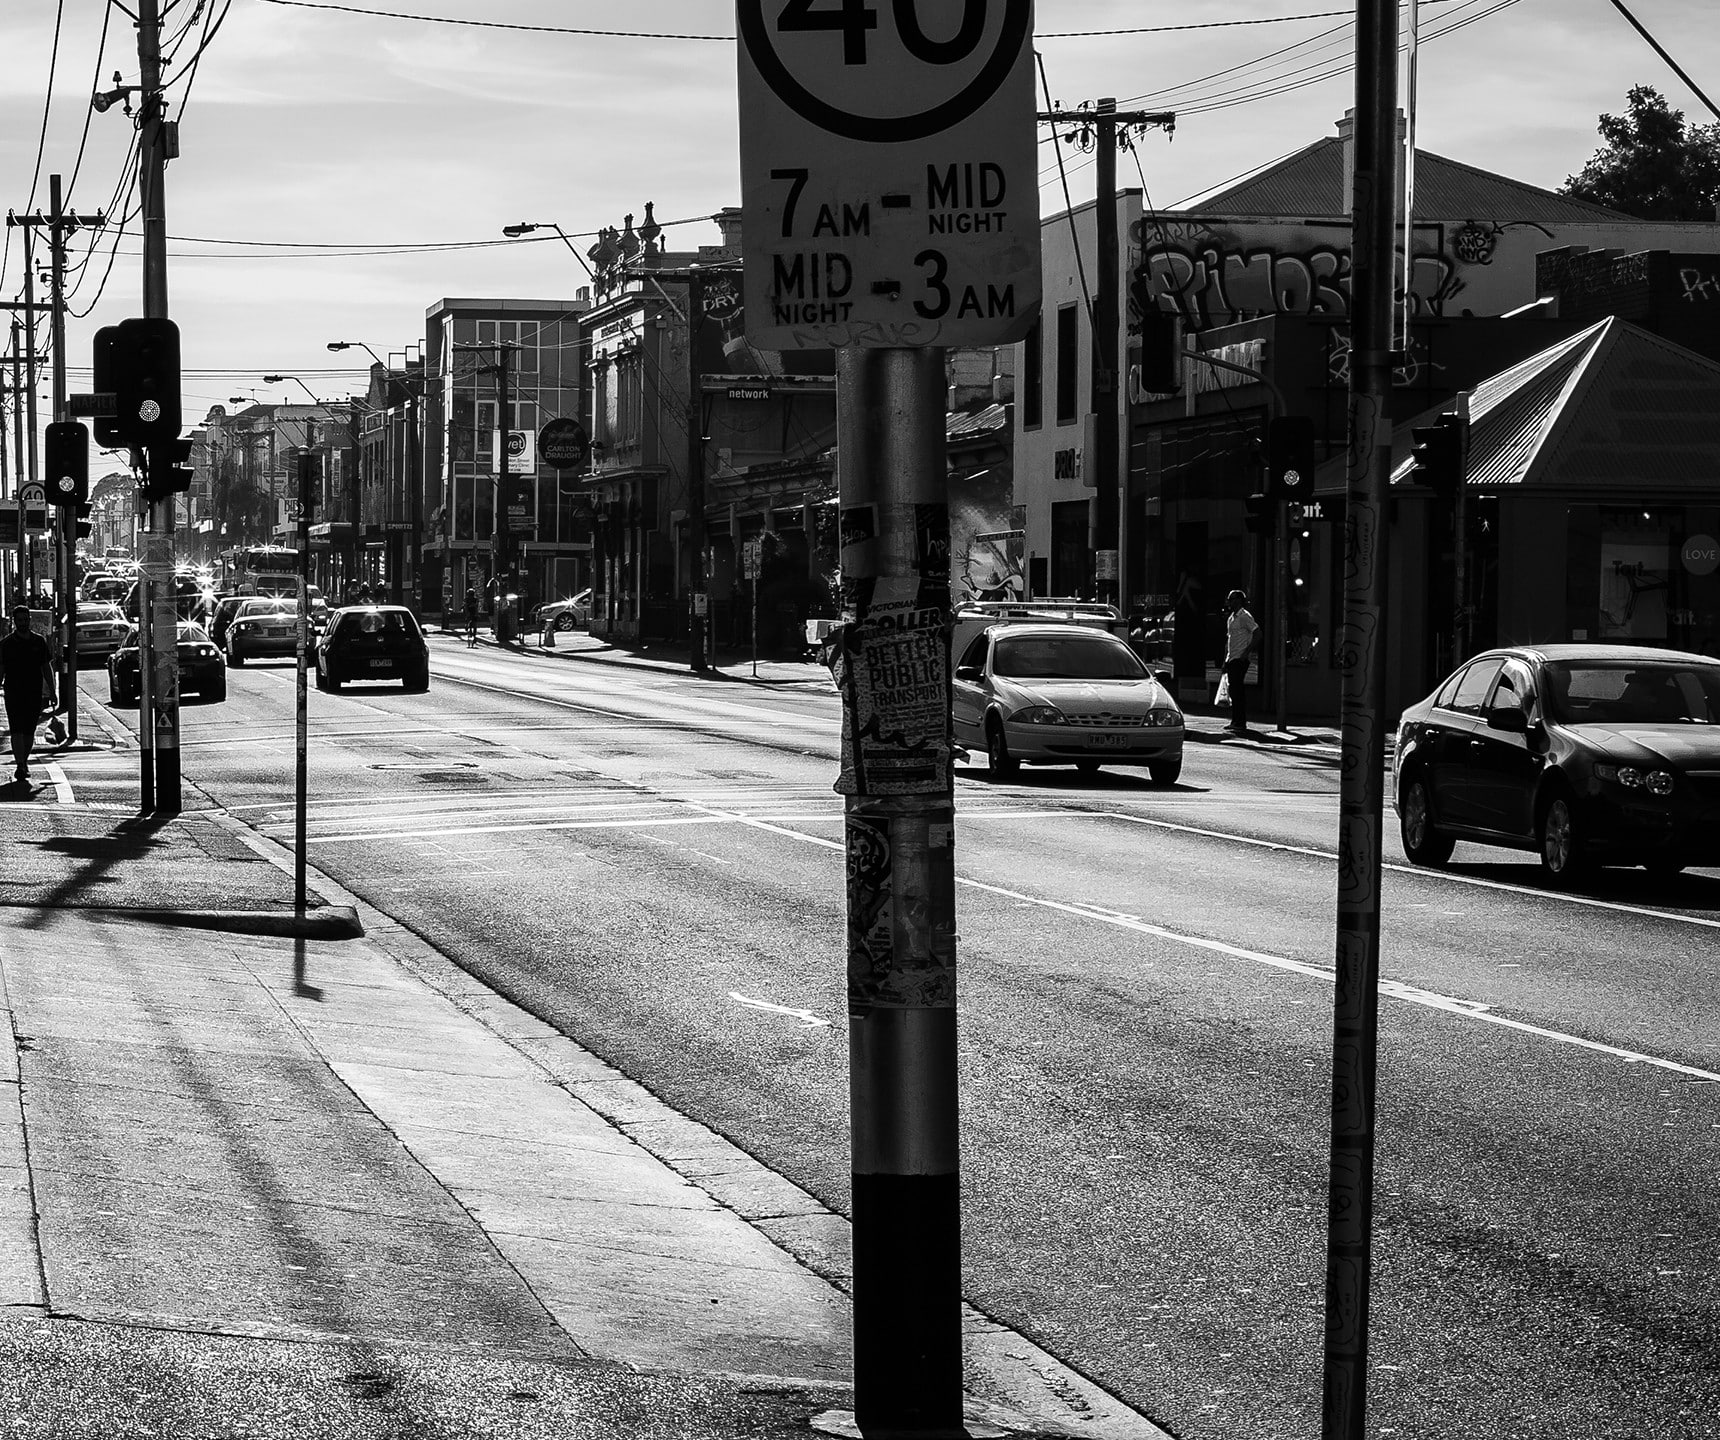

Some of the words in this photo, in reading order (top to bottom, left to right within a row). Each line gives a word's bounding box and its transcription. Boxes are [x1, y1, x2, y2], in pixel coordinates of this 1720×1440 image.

[926, 162, 1007, 210] MID
[928, 212, 1007, 235] NIGHT
[771, 250, 854, 300] MID
[773, 302, 854, 326] NIGHT
[728, 389, 769, 399] network
[544, 452, 582, 460] DRAUGHT
[546, 445, 581, 453] CARLTON
[1685, 549, 1716, 560] LOVE
[867, 600, 917, 615] VICTORIAN
[866, 636, 938, 667] BETTER
[870, 659, 941, 692] PUBLIC
[872, 683, 942, 707] TRANSPORT
